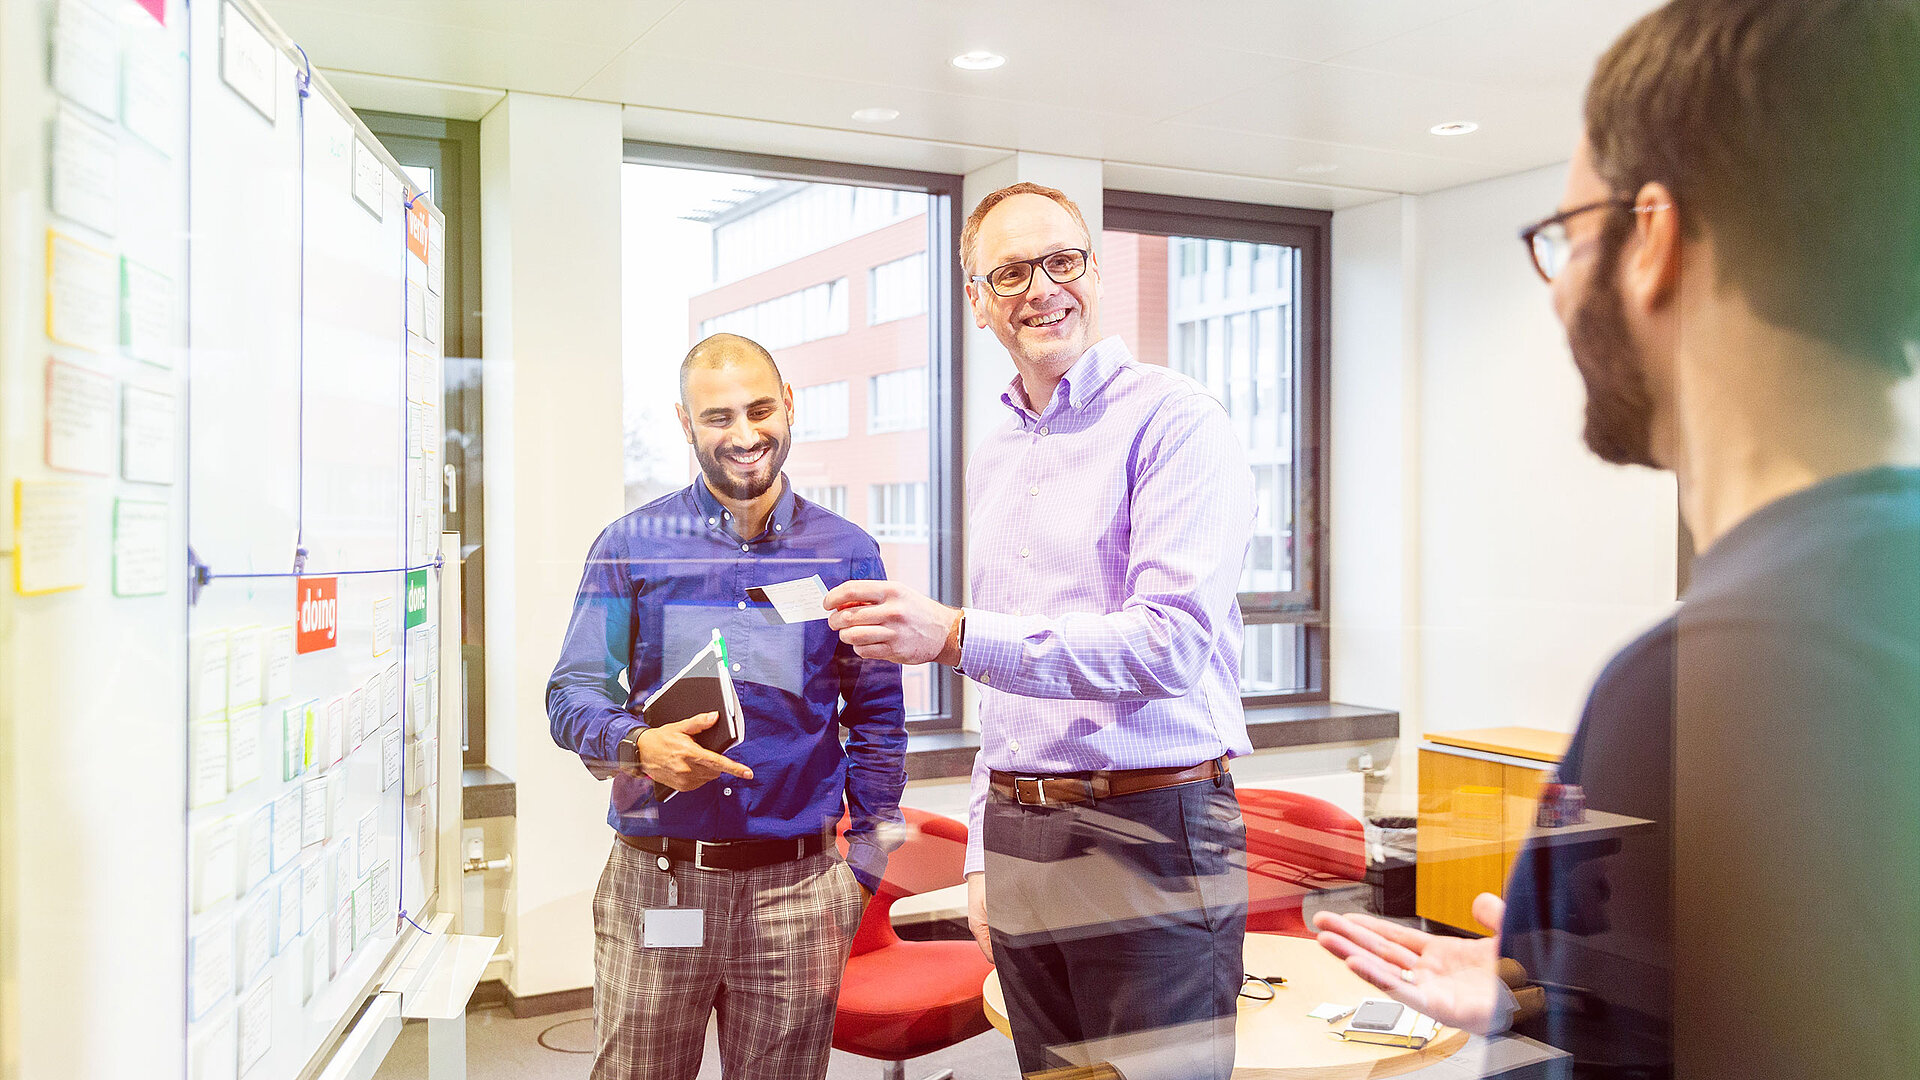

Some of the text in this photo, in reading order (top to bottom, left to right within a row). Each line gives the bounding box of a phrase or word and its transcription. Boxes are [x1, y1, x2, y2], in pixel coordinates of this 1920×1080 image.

[410, 209, 428, 256] verify
[302, 588, 336, 638] doing
[408, 580, 426, 614] done
